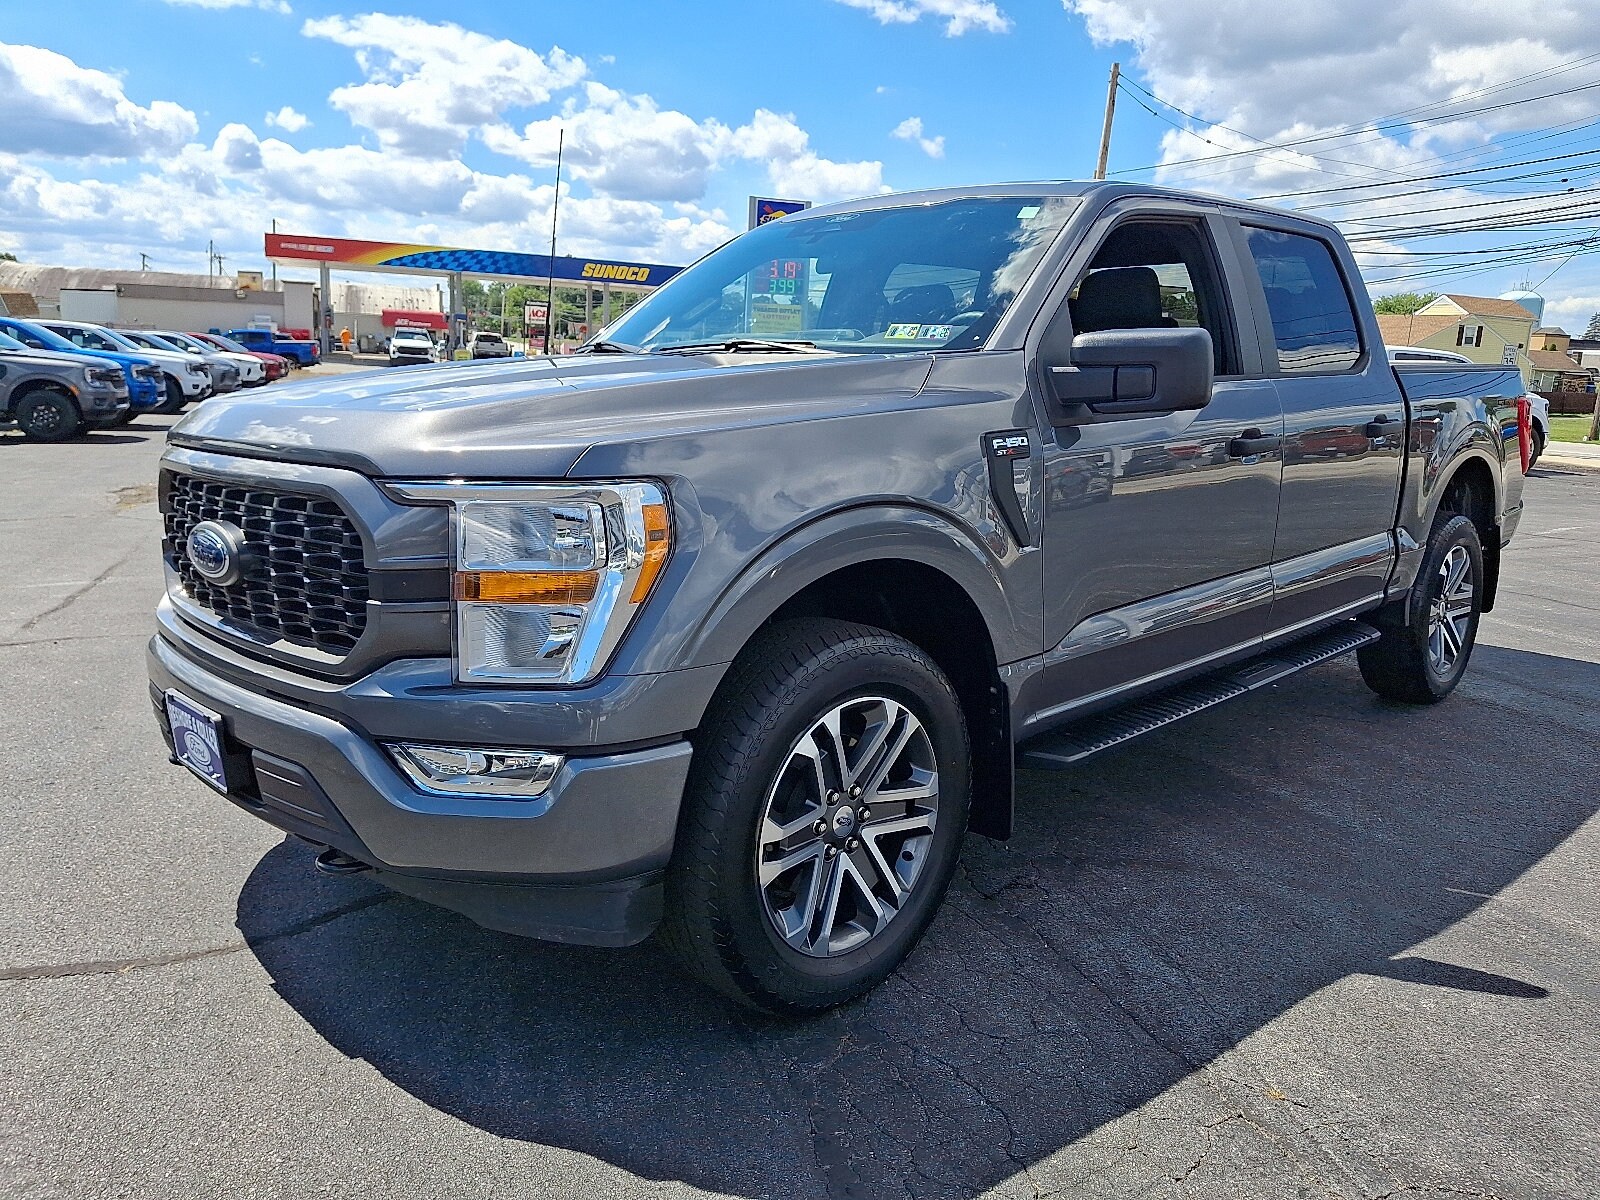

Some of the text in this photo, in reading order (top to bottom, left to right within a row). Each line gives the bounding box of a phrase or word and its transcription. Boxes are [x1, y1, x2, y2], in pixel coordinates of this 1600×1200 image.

[582, 263, 650, 281] SUNOCO
[1504, 357, 1514, 365] 35
[992, 436, 1028, 449] F-150
[189, 736, 205, 759] Ford
